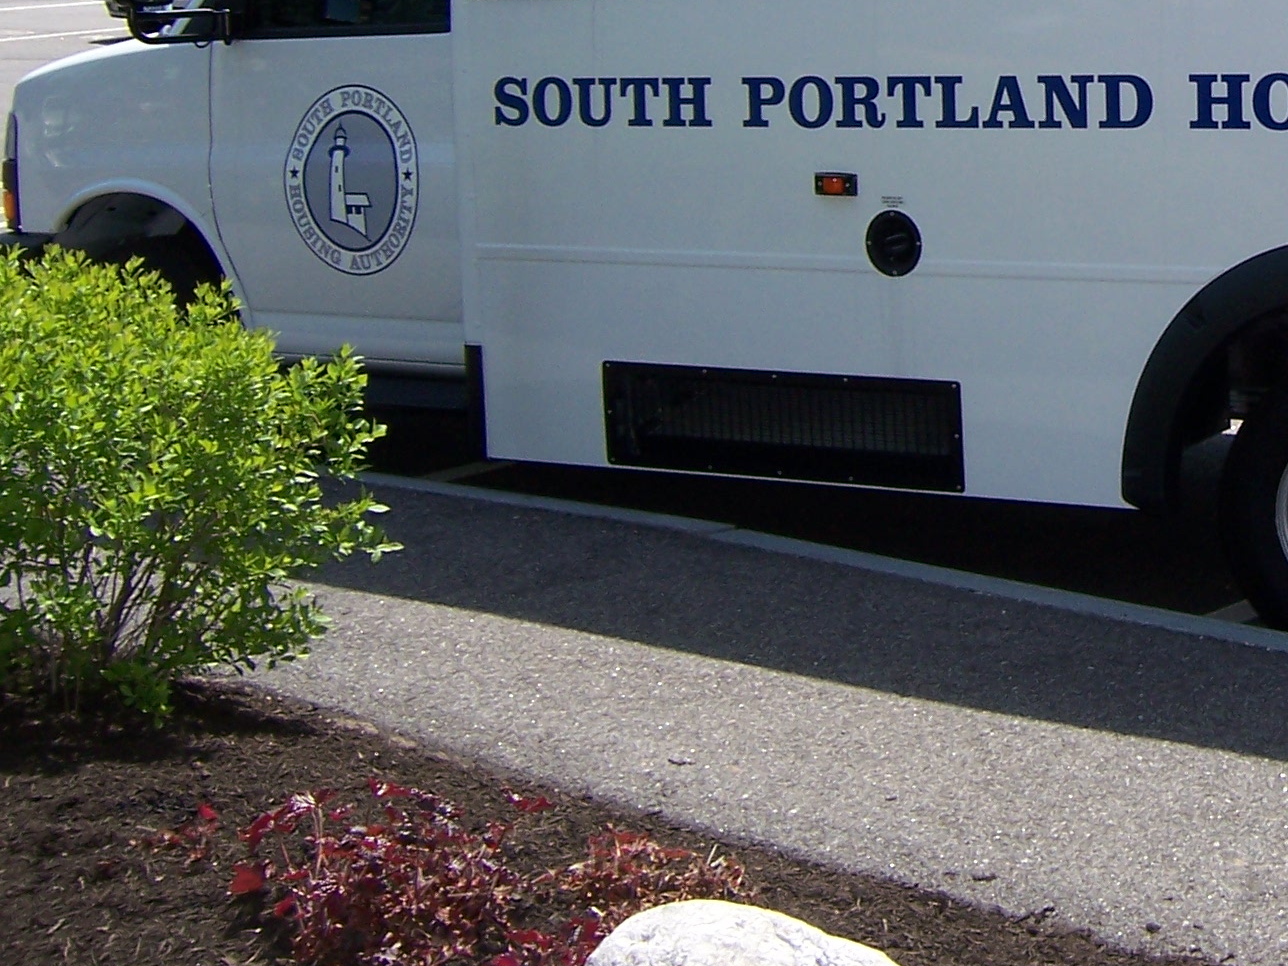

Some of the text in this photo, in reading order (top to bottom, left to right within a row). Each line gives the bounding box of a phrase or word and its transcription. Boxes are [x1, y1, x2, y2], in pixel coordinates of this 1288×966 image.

[293, 90, 414, 164] SOUTH PORTLAND
[494, 77, 712, 128] SOUTH
[742, 75, 1153, 129] PORTLAND
[289, 185, 414, 270] HOUSING AUTHORITY
